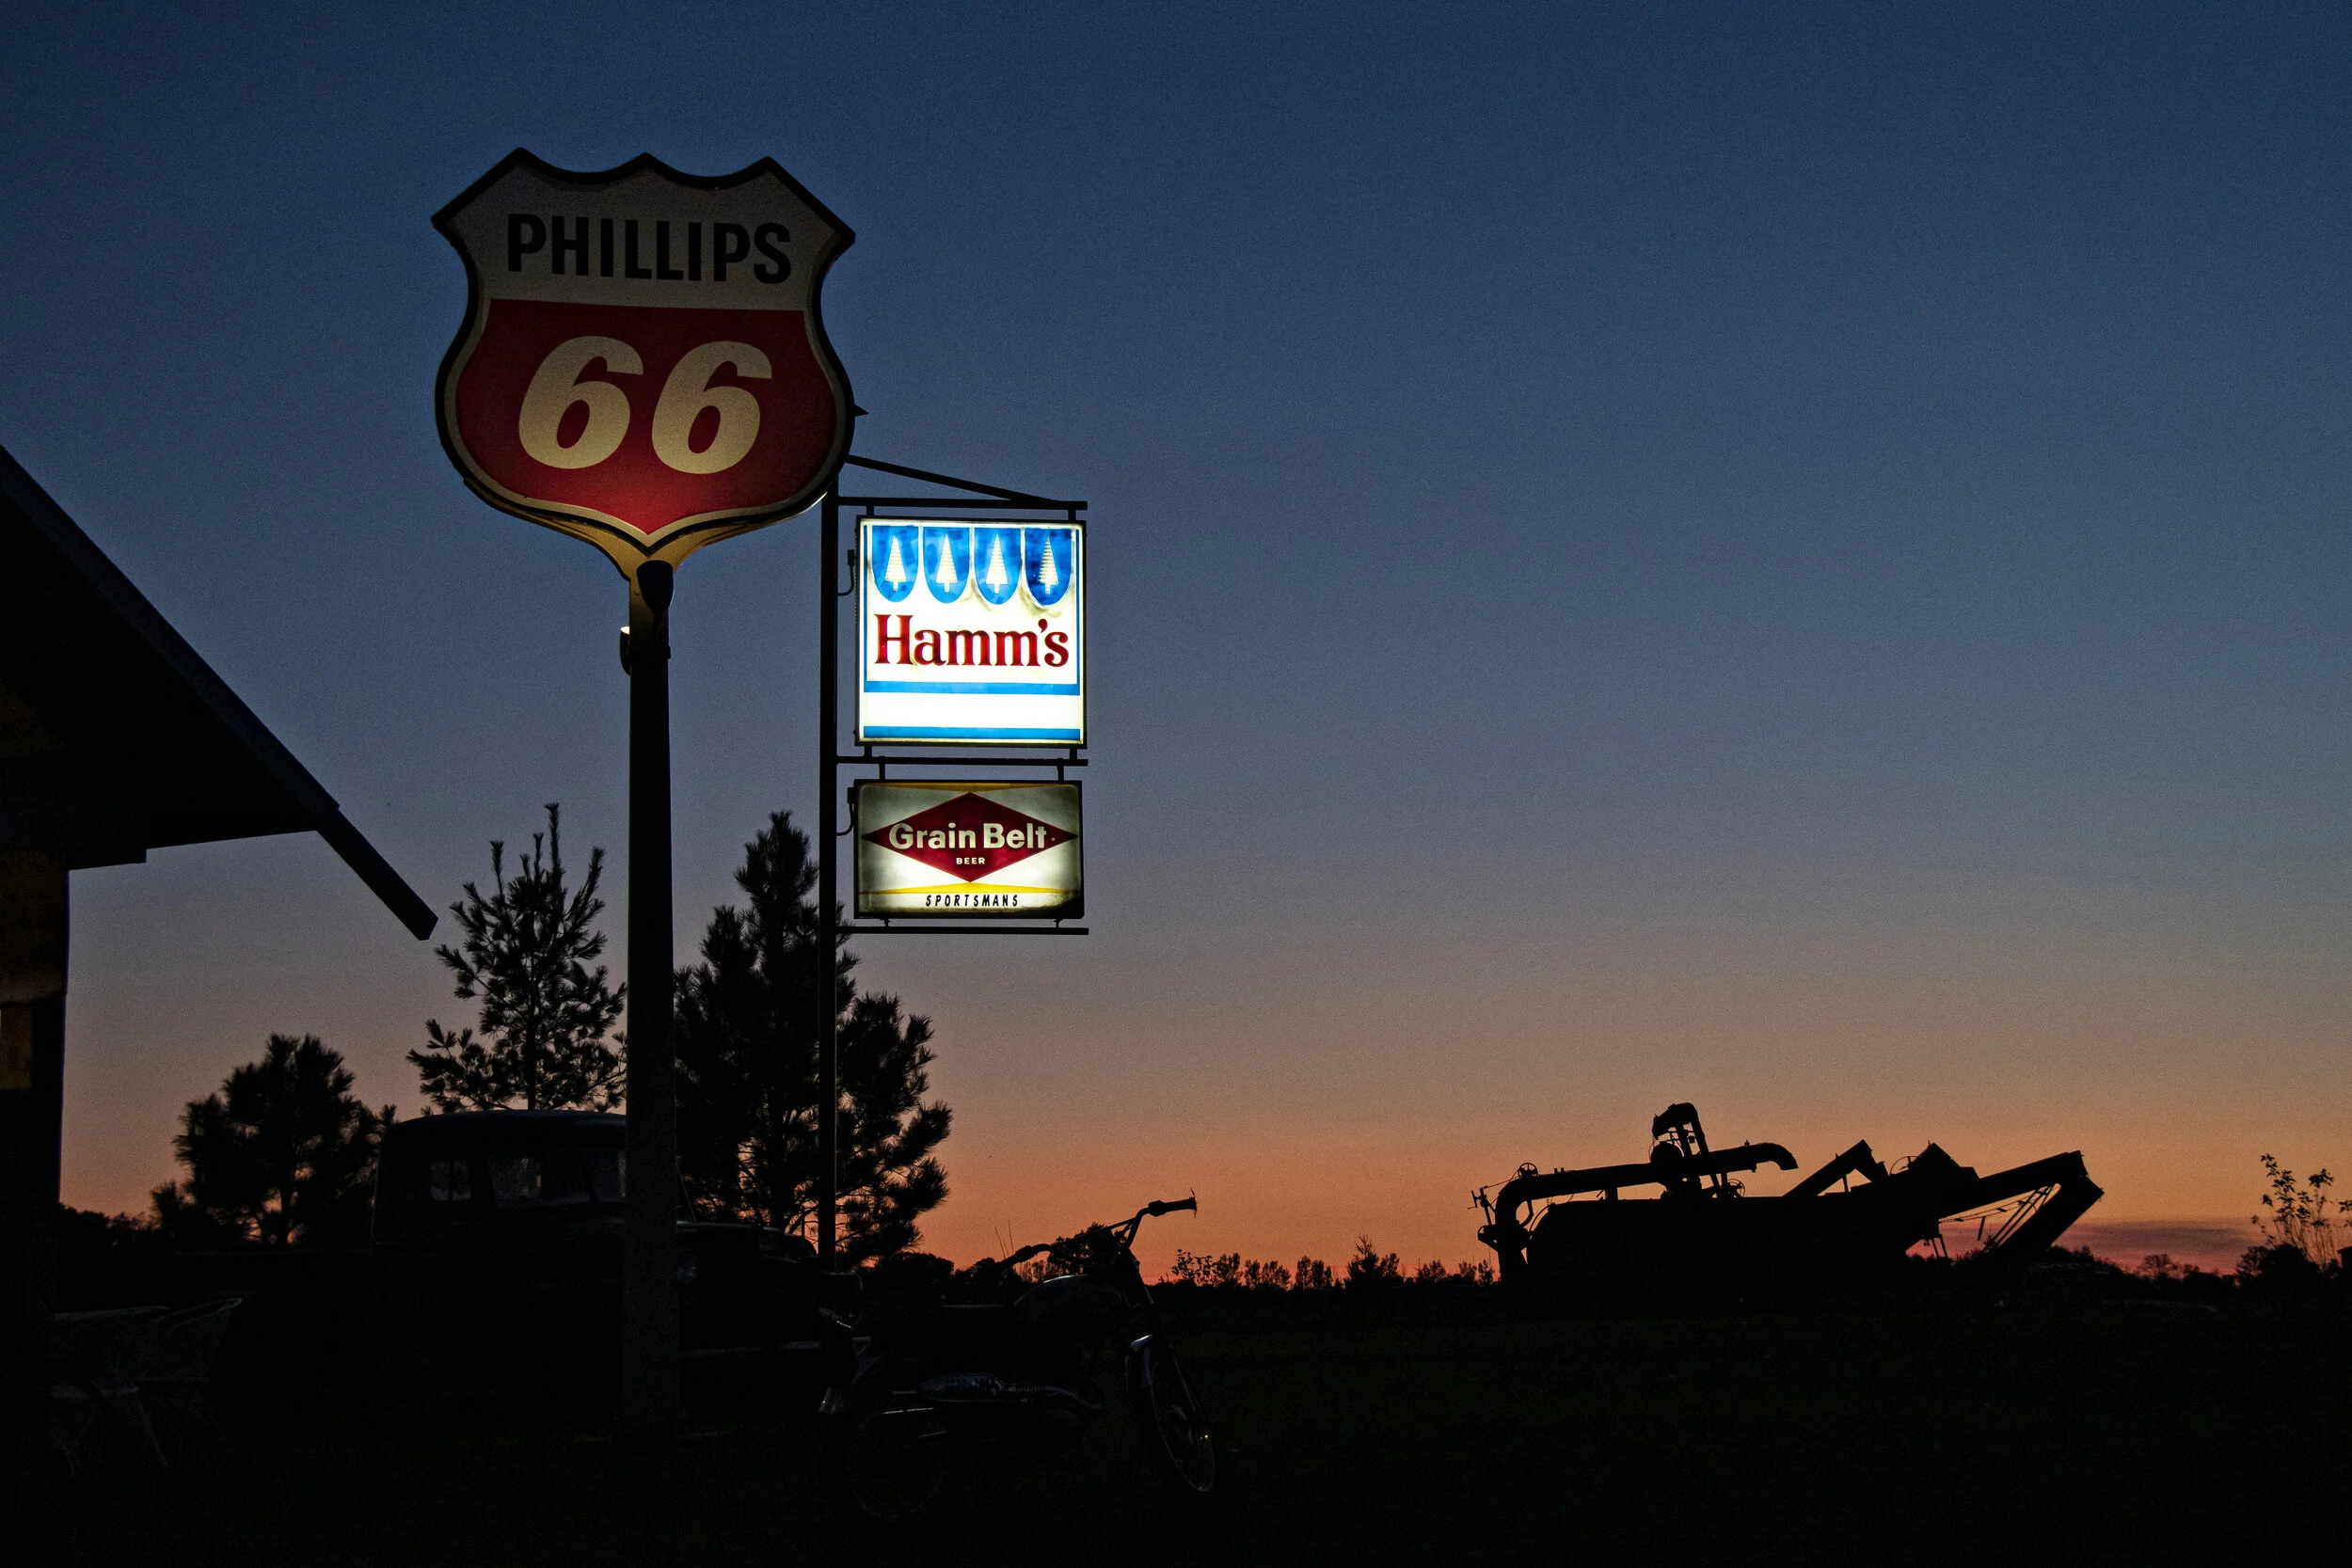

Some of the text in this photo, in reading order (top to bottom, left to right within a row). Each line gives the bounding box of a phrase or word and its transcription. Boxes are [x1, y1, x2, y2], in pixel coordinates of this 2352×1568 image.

[507, 213, 791, 284] PHILLIPS
[518, 335, 772, 474] 66
[873, 613, 1070, 668] Hamm's
[888, 822, 1047, 850] Grain Belt
[926, 894, 1019, 908] SPORTSMANS
